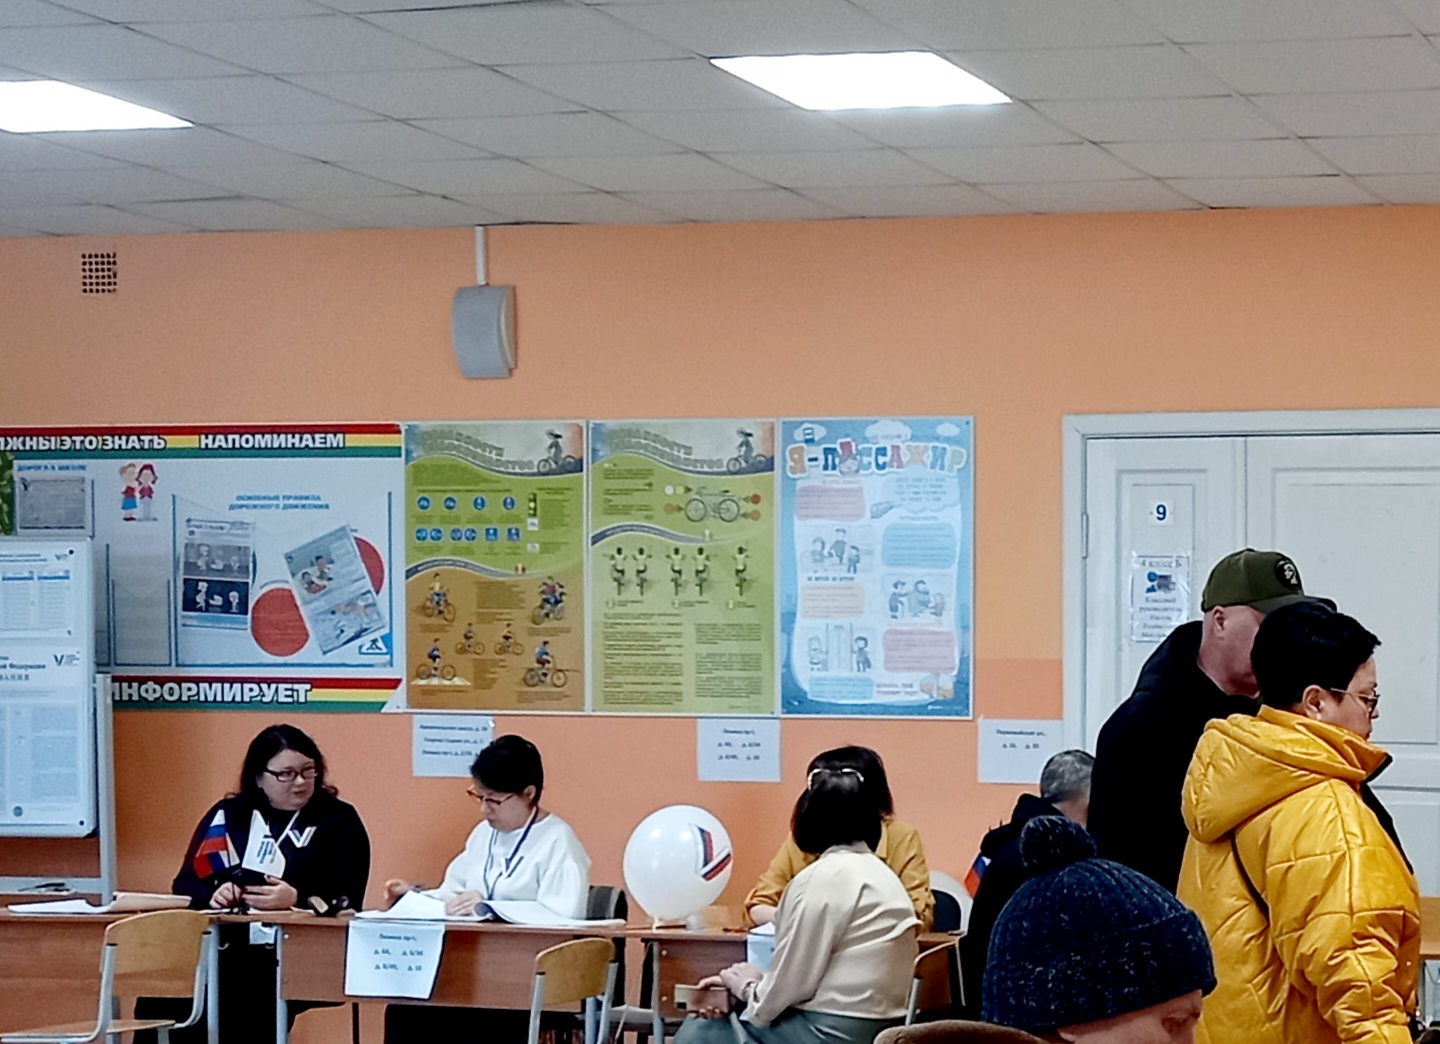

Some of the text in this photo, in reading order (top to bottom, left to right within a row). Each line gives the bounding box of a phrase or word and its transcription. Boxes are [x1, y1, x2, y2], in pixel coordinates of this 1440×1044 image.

[60, 435, 98, 450] ЭТО
[103, 435, 166, 450] ЗНАТЬ
[200, 433, 344, 449] НАПОМИНАЕМ
[282, 494, 321, 502] ПРАВИЛА
[228, 502, 330, 511] ДОРОЖНОГО ДВИЖЕНИЯ
[1155, 503, 1167, 521] 9
[112, 681, 311, 703] ИНФОРМИРУЕТ
